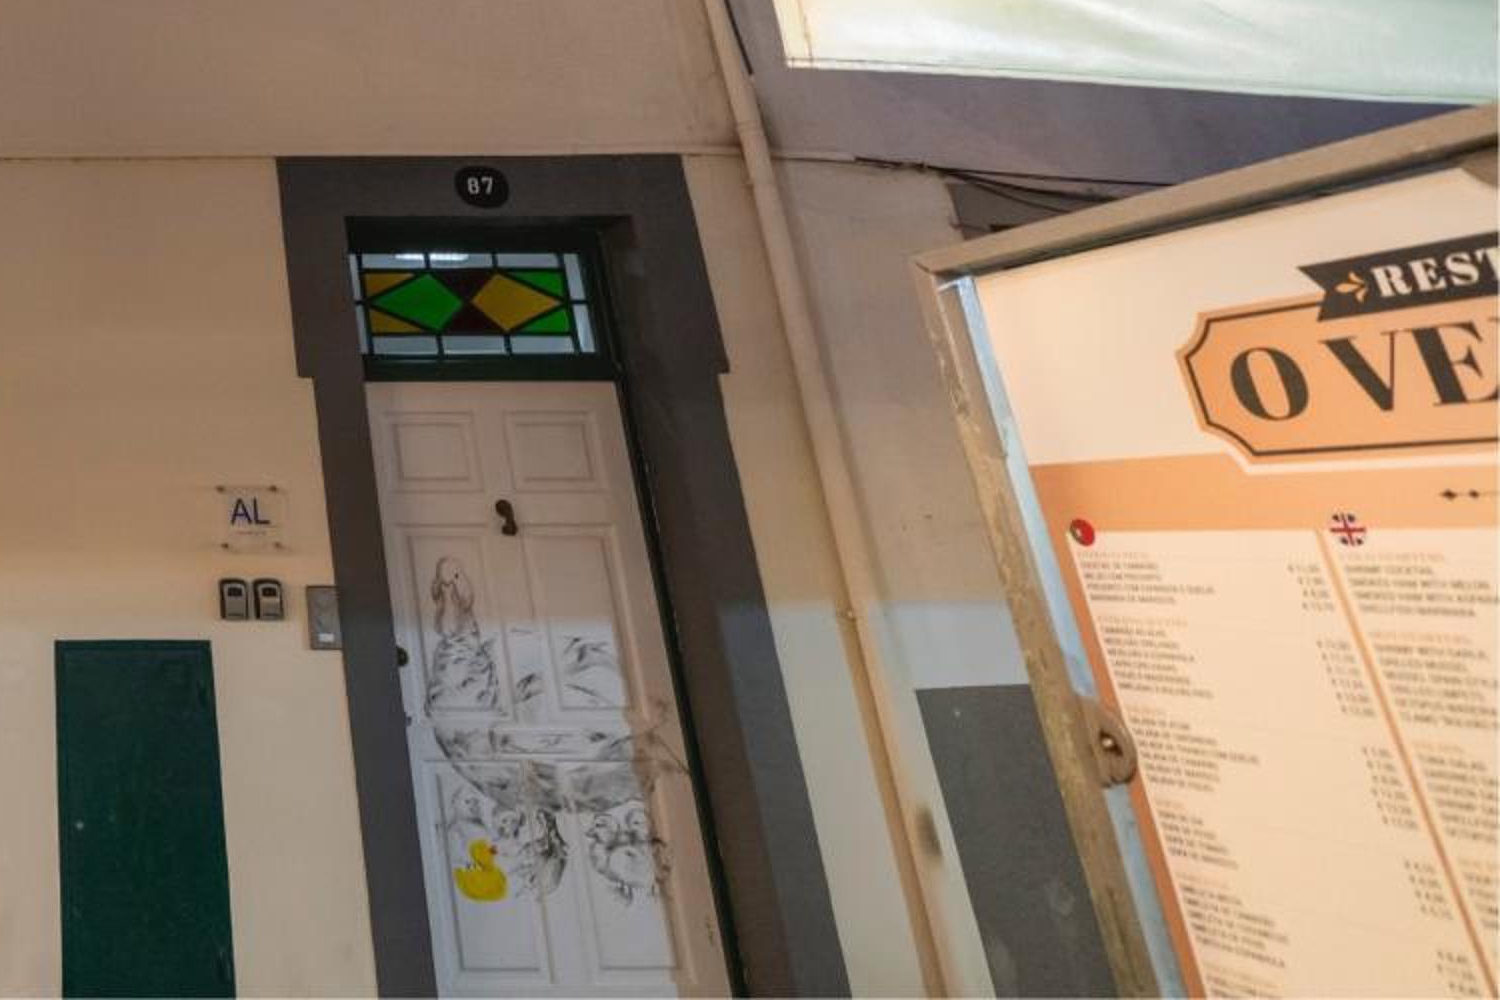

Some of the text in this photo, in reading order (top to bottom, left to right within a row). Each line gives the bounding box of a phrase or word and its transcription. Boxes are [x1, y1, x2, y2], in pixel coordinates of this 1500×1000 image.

[467, 176, 493, 195] 87
[1230, 317, 1500, 421] O VE
[230, 497, 271, 525] AL
